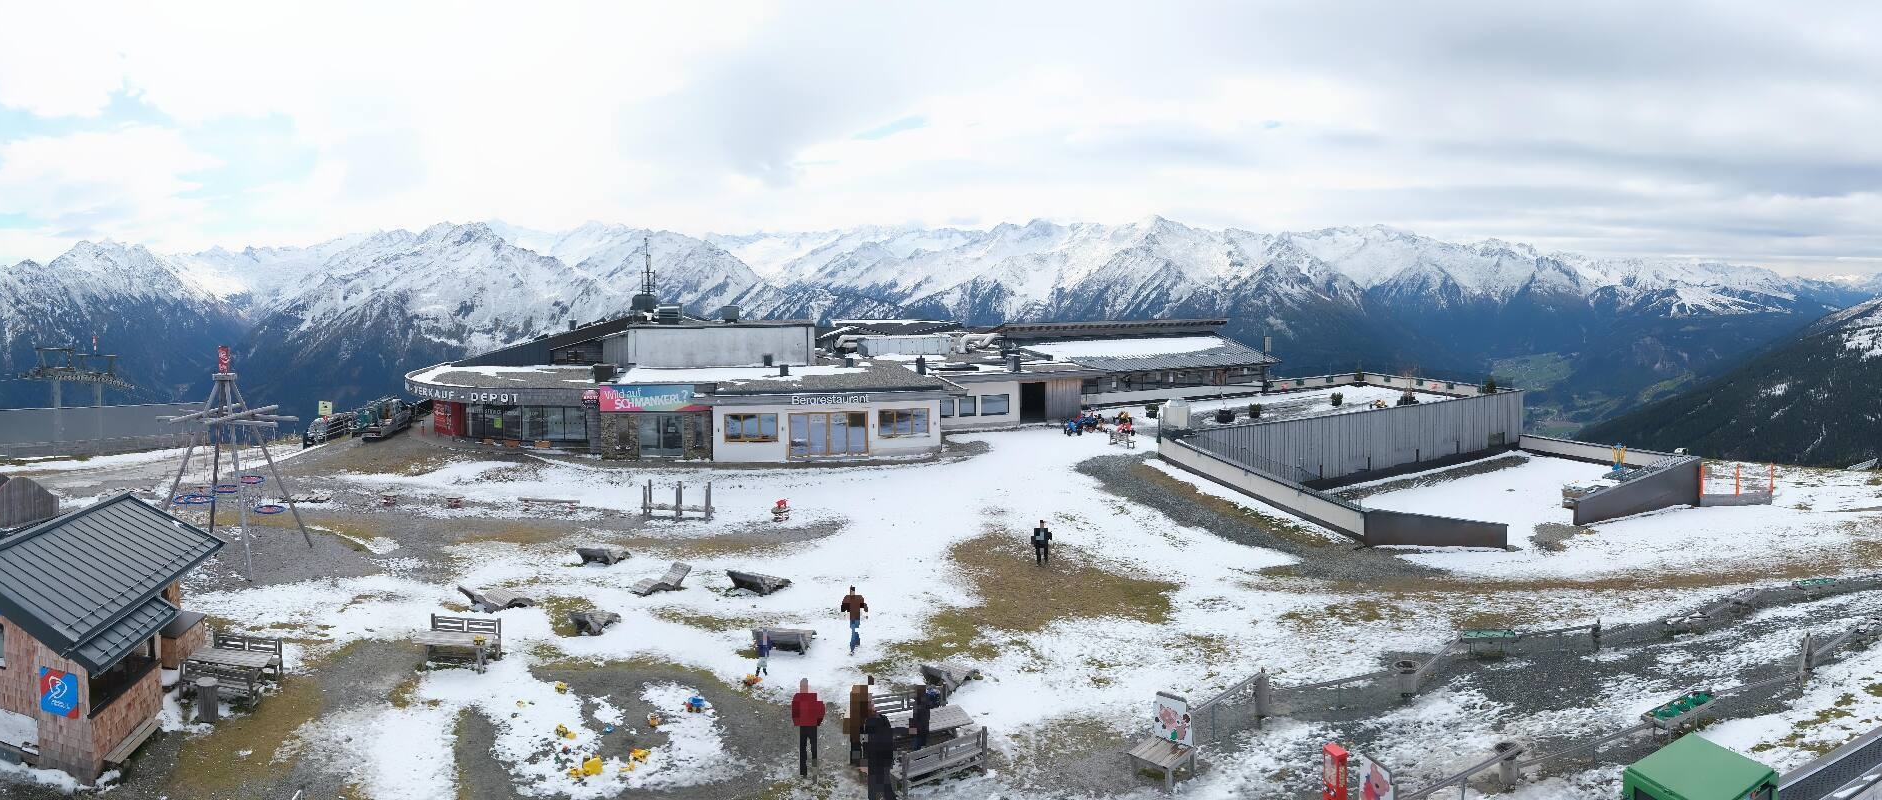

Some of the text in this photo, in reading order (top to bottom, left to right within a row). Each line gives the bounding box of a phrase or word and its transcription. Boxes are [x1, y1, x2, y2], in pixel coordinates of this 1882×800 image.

[414, 385, 455, 400] VERKAUF
[471, 392, 519, 403] DEPOT
[604, 388, 625, 400] Wild
[627, 387, 642, 398] auf
[614, 390, 689, 409] SCHMANKERL?
[791, 394, 869, 407] Bergrestaurant
